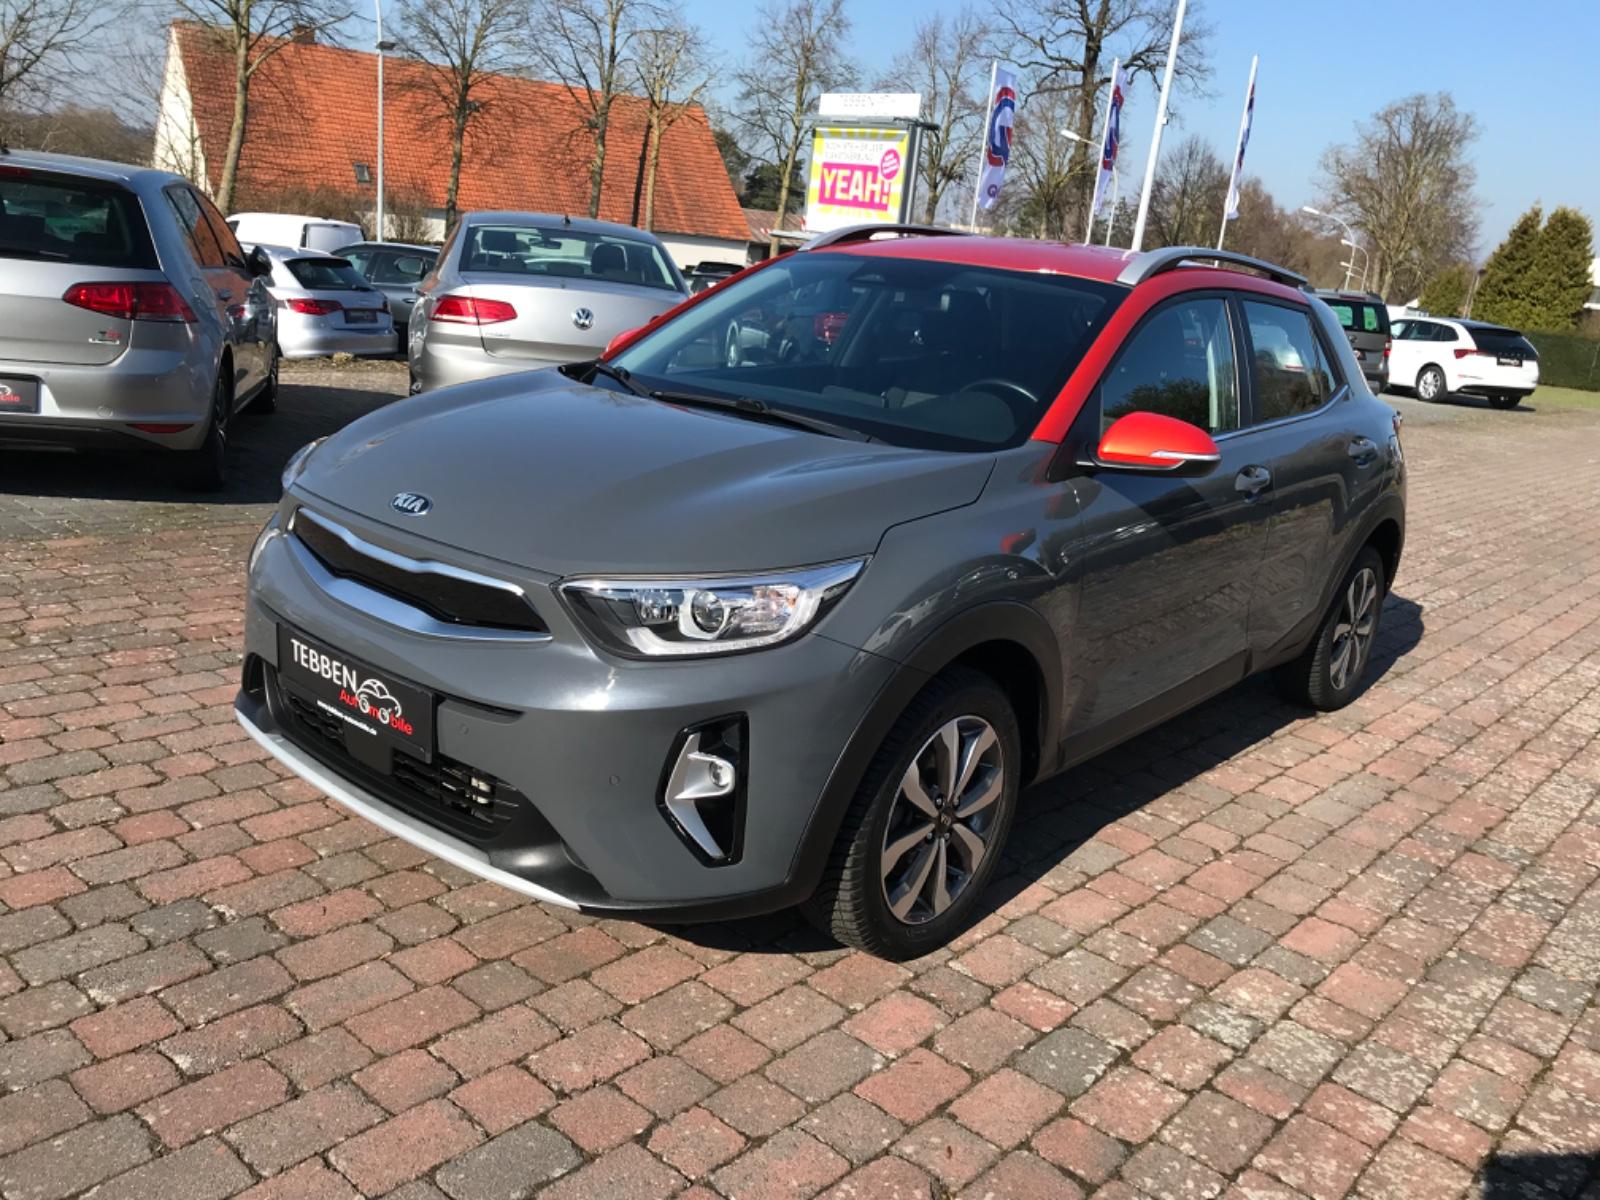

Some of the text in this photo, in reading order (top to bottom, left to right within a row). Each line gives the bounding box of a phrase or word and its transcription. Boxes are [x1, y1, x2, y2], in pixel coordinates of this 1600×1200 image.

[822, 167, 890, 205] YEAH!
[393, 493, 425, 512] KIA
[290, 638, 357, 693] TEBBEN
